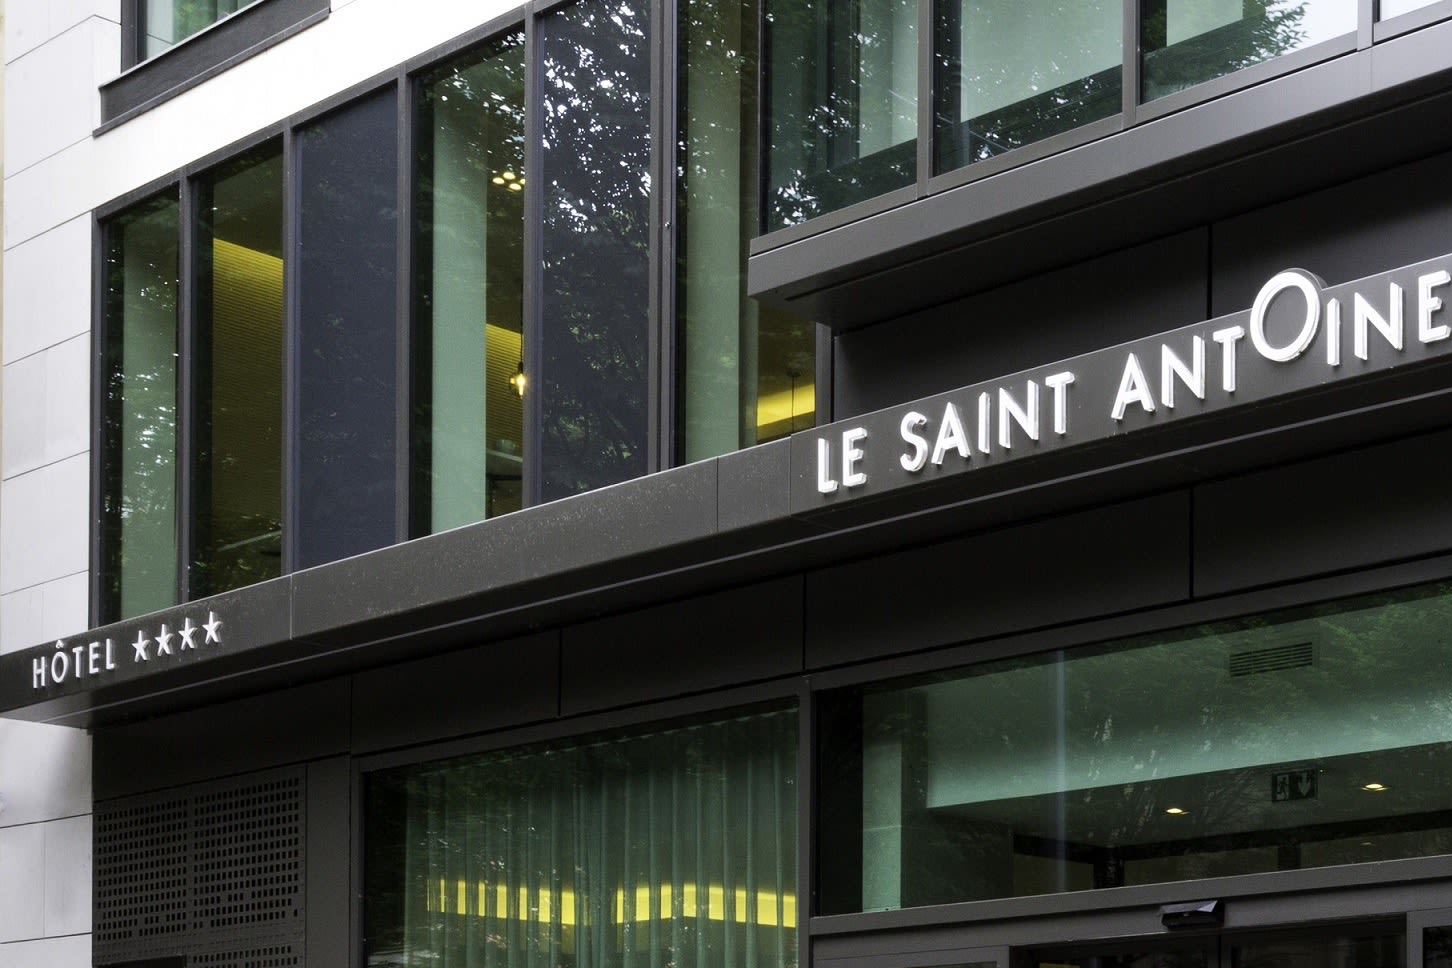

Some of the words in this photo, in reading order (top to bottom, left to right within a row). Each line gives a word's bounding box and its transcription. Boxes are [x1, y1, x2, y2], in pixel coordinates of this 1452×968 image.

[817, 427, 868, 493] LE
[900, 371, 1075, 472] SAINT
[1111, 268, 1451, 420] ANTOINE
[32, 638, 117, 689] HÔTEL
